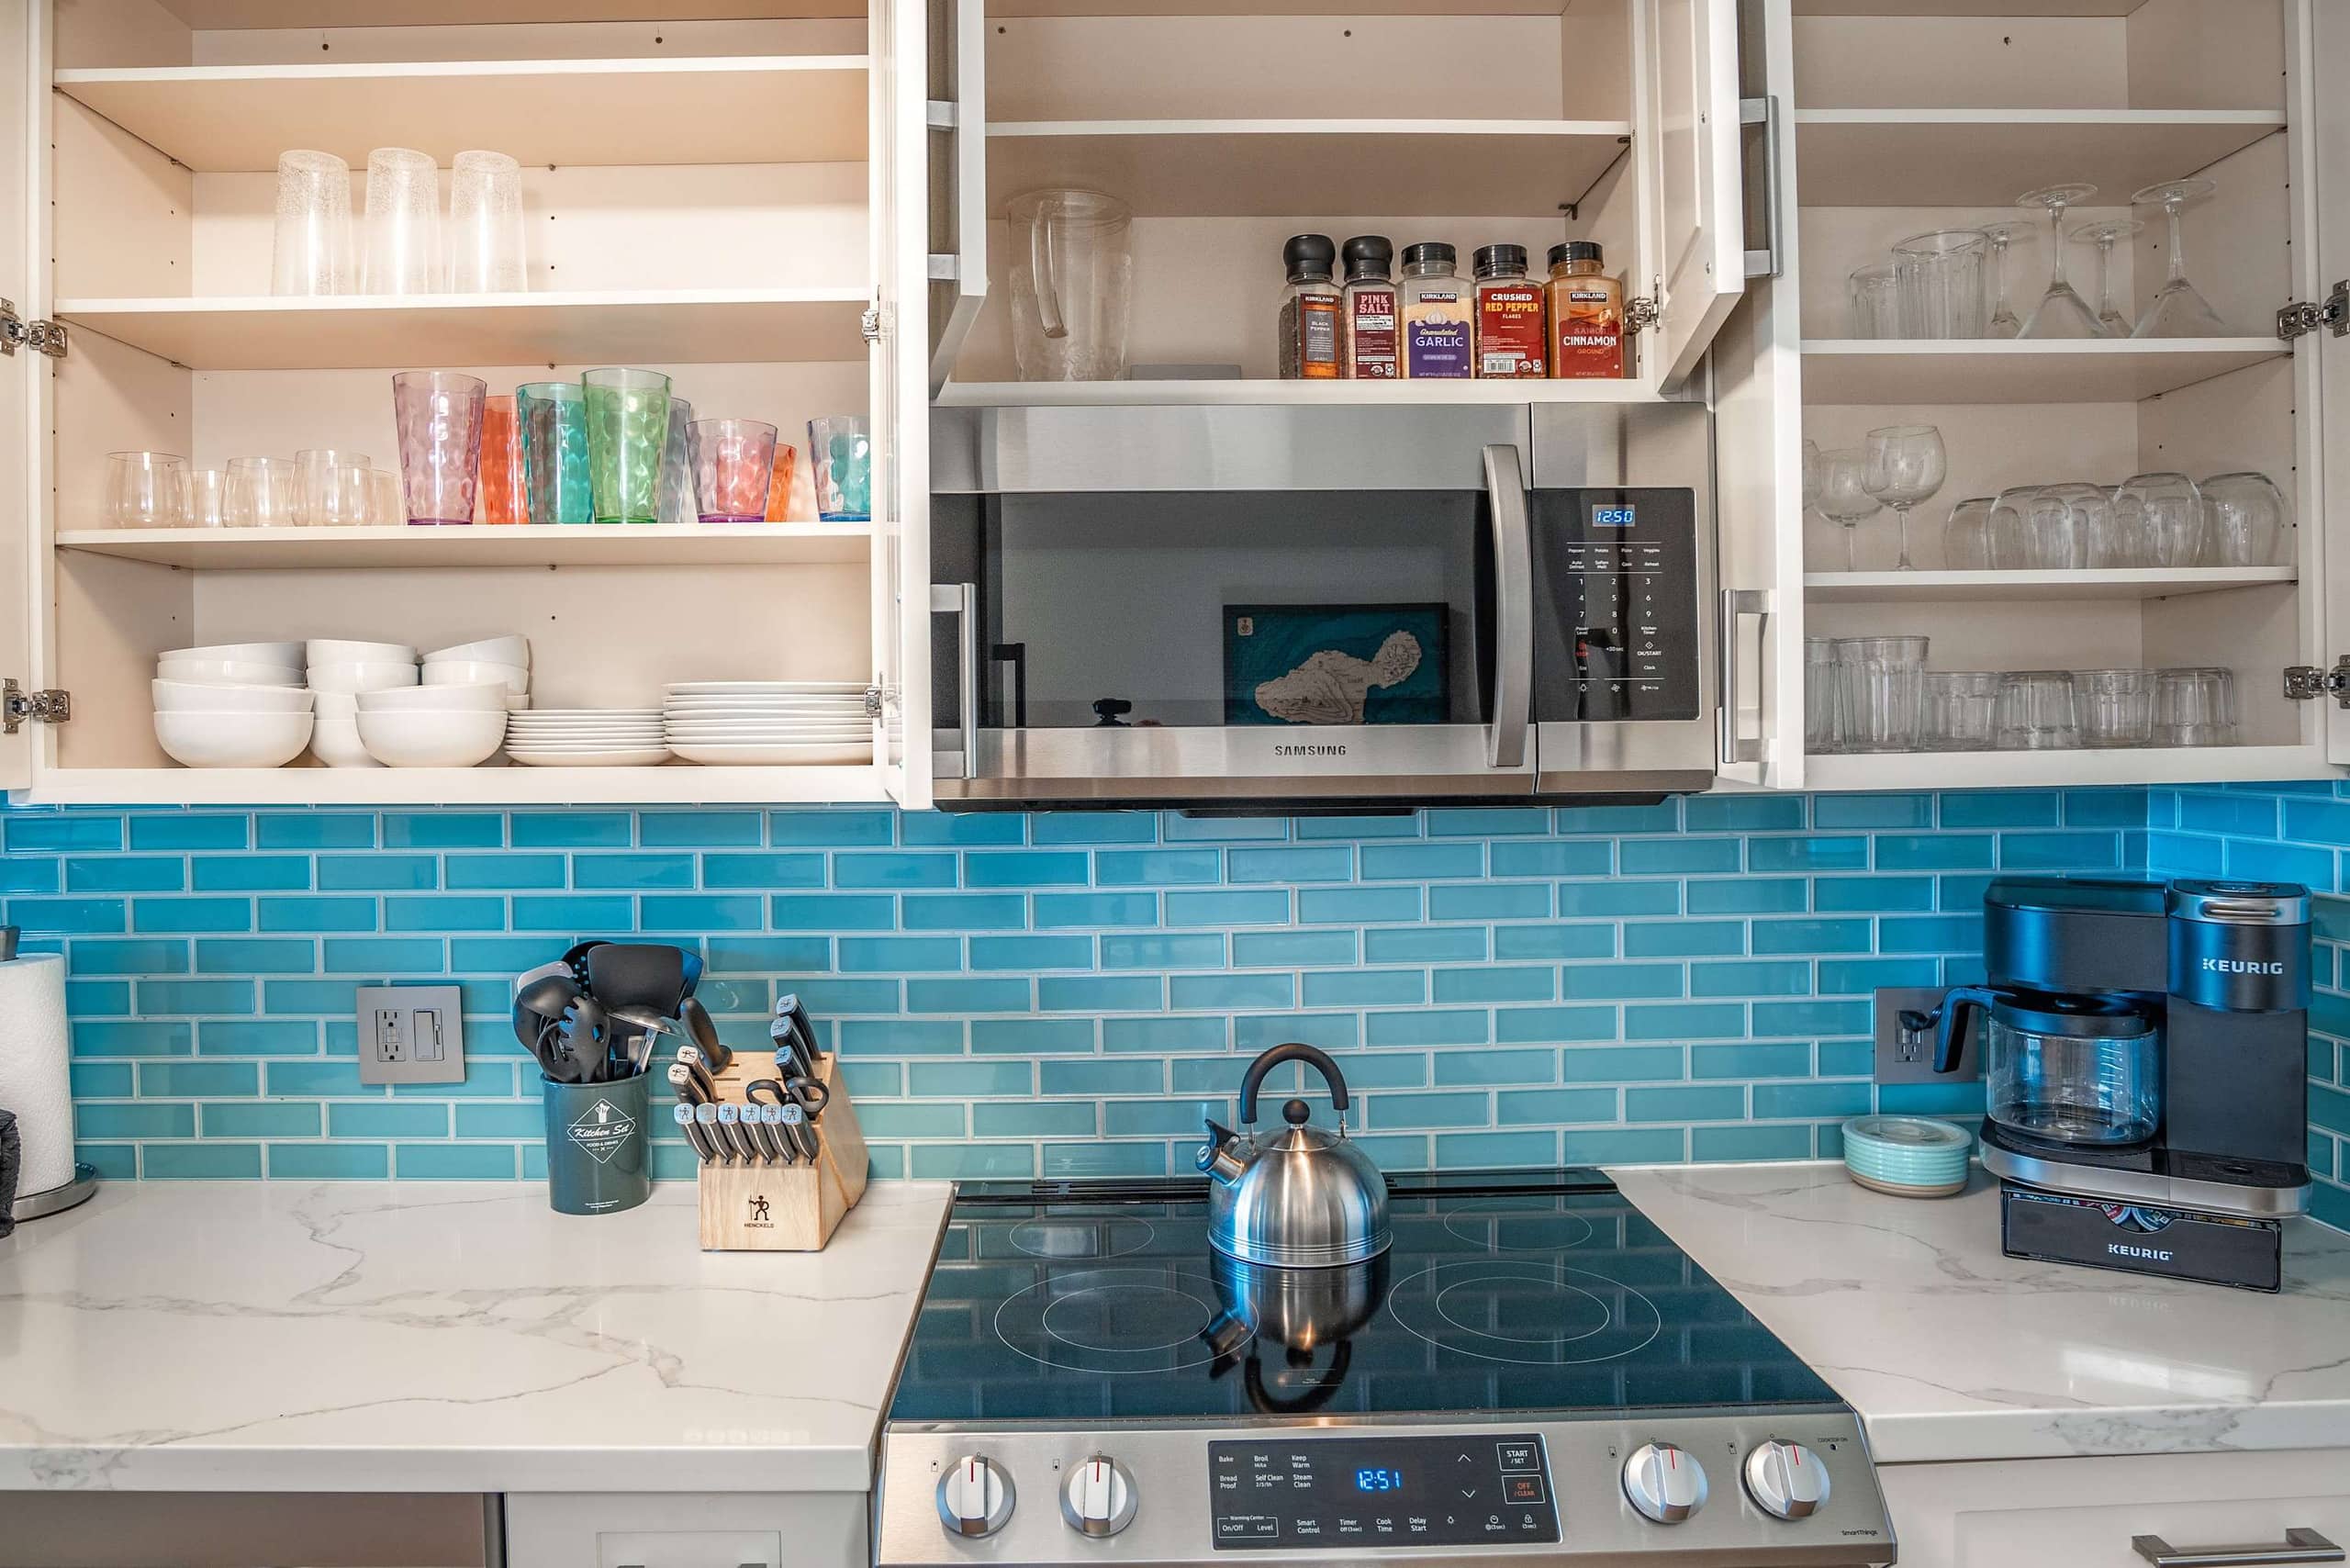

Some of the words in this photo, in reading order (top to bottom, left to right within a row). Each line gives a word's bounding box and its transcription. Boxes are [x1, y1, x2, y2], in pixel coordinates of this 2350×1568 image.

[1360, 295, 1388, 304] PINK
[1359, 304, 1390, 314] SALT
[1485, 303, 1503, 312] RED
[1505, 303, 1539, 312] PEPPER
[1416, 337, 1463, 347] GARLIC
[1563, 336, 1617, 346] CINNAMON
[1274, 745, 1347, 756] SAMSUNG
[2203, 958, 2283, 975] KEURIG
[574, 1126, 610, 1137] Kitchen
[612, 1124, 630, 1135] Set
[2108, 1243, 2172, 1261] KEURIG
[1359, 1471, 1400, 1489] 12:51
[1841, 1528, 1878, 1536] SmartThings
